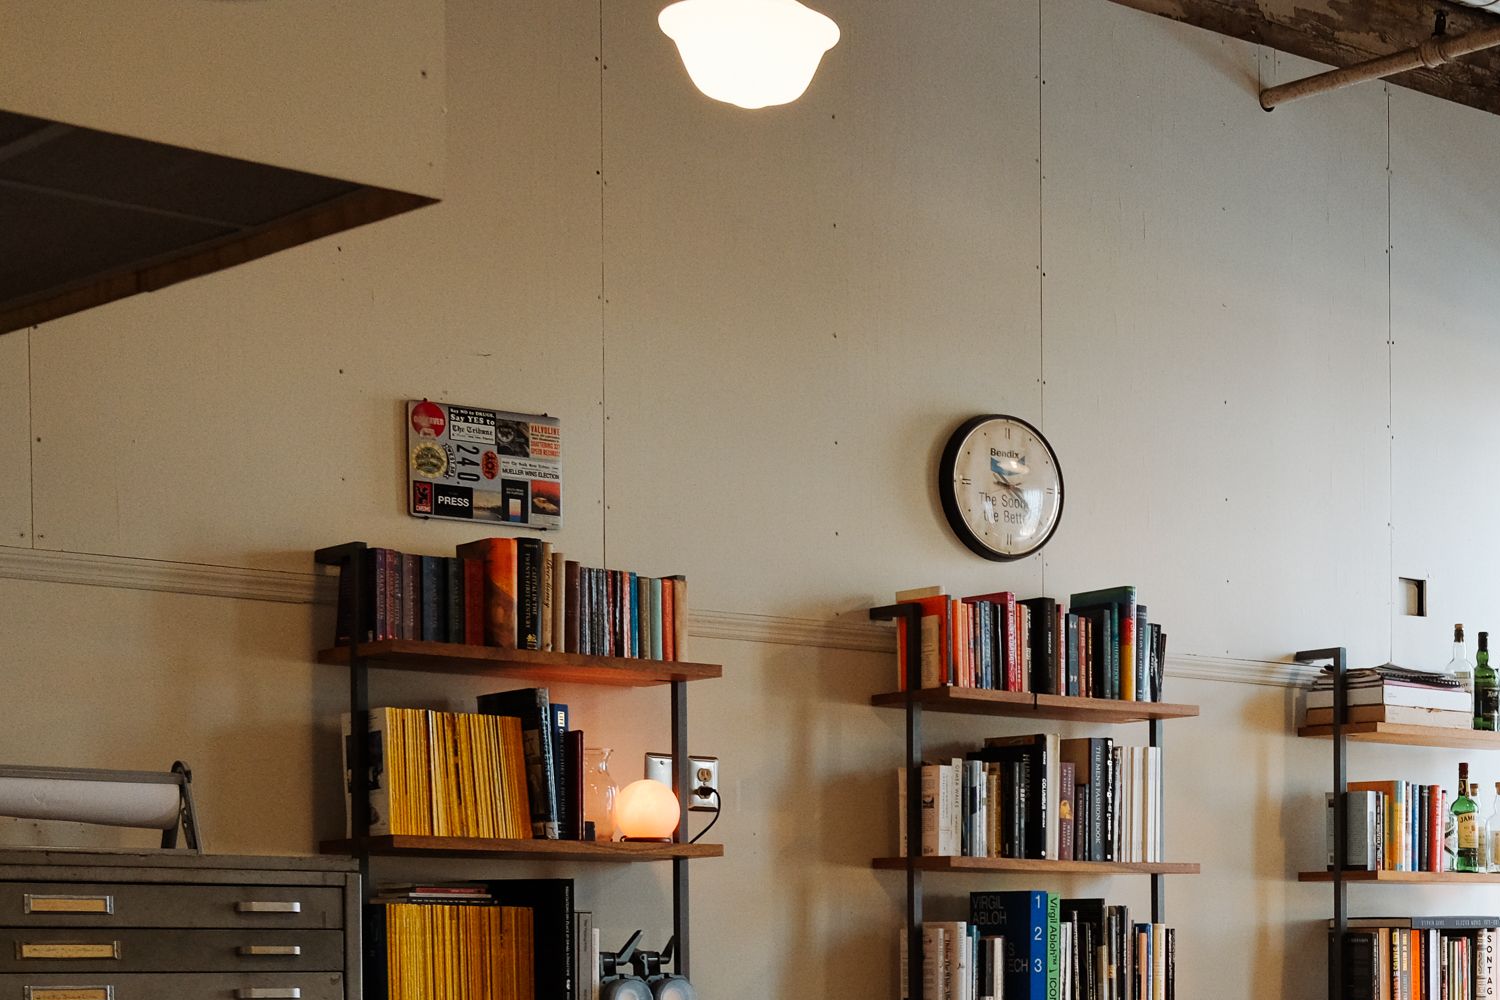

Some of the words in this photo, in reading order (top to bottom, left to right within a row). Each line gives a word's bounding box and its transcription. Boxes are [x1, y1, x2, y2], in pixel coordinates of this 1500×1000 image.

[450, 414, 465, 422] Say
[467, 416, 484, 424] YES
[486, 418, 495, 426] to
[452, 425, 465, 434] The
[990, 447, 1019, 459] Bendix
[502, 468, 524, 476] MUELLER
[538, 472, 560, 480] ELECTION
[438, 495, 470, 507] PRESS
[972, 895, 1004, 910] VIRGIL
[1035, 894, 1041, 909] 1
[1048, 897, 1058, 923] Virgil
[973, 911, 1007, 925] ABLOH
[1034, 926, 1042, 941] 2
[1034, 958, 1042, 973] 3
